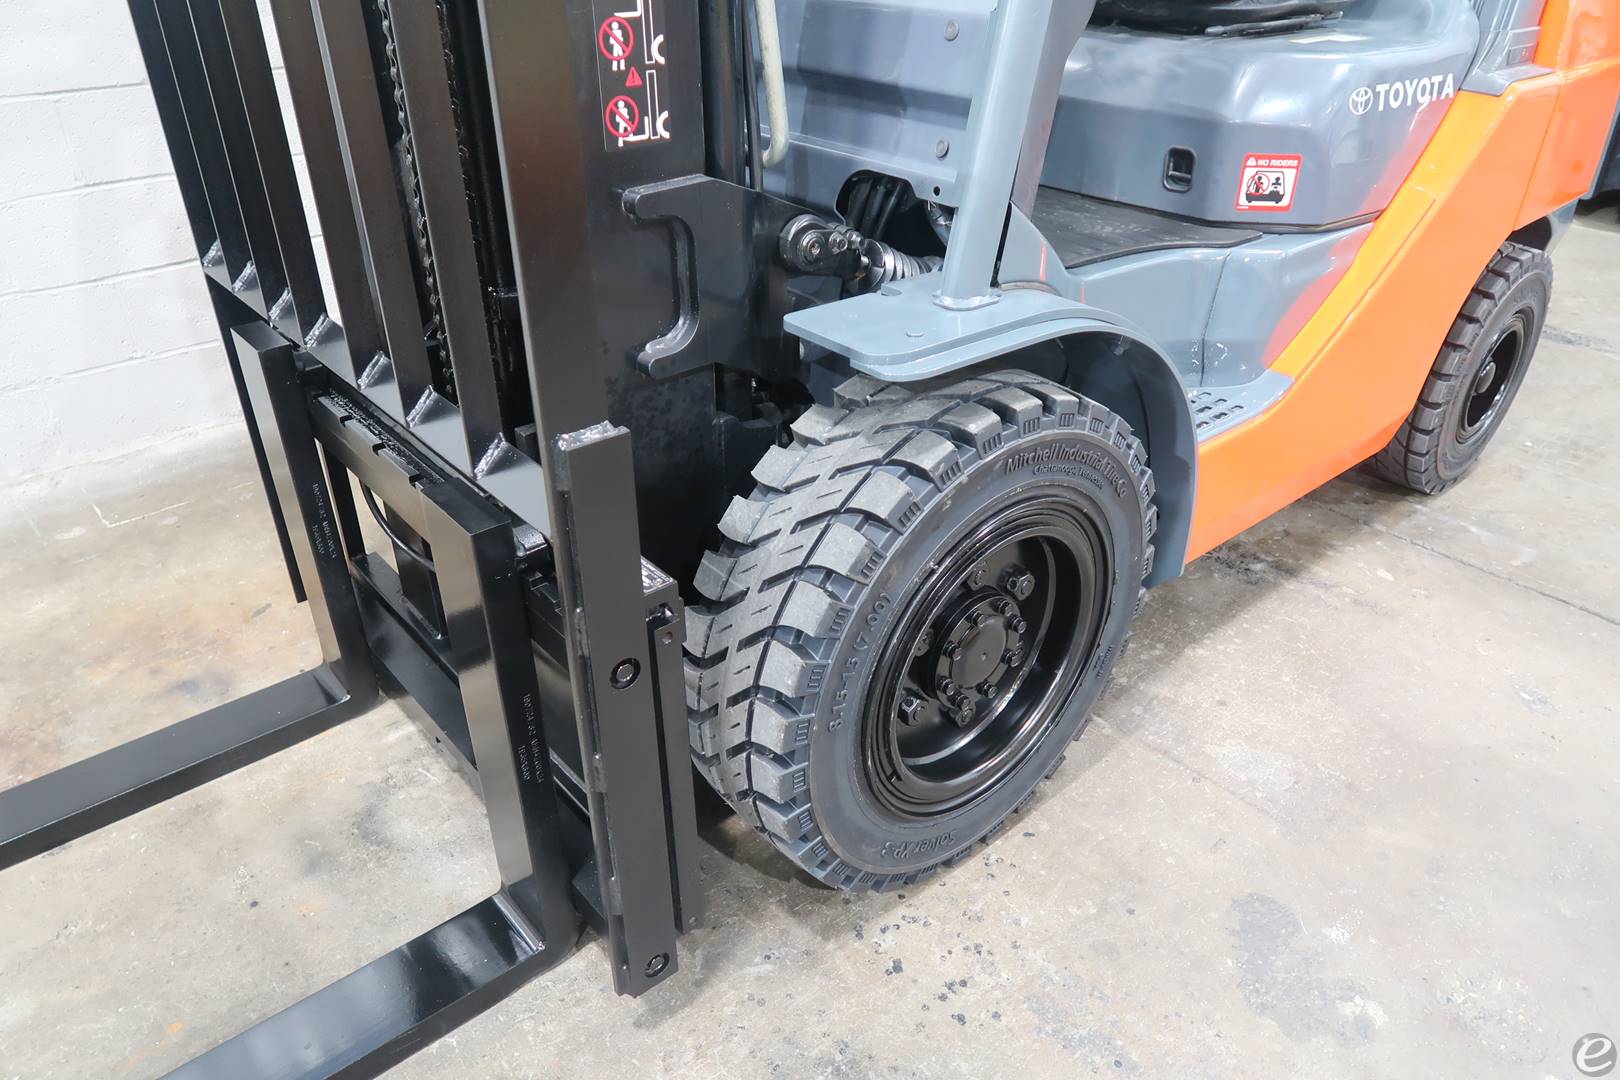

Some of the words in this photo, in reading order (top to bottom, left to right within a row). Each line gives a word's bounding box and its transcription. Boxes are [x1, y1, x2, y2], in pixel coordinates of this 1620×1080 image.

[1375, 73, 1454, 112] TOYOTA
[1257, 159, 1270, 167] NO
[1270, 159, 1298, 167] RIDERS
[1006, 443, 1059, 475] Mitchell
[853, 592, 891, 650] (7.00)
